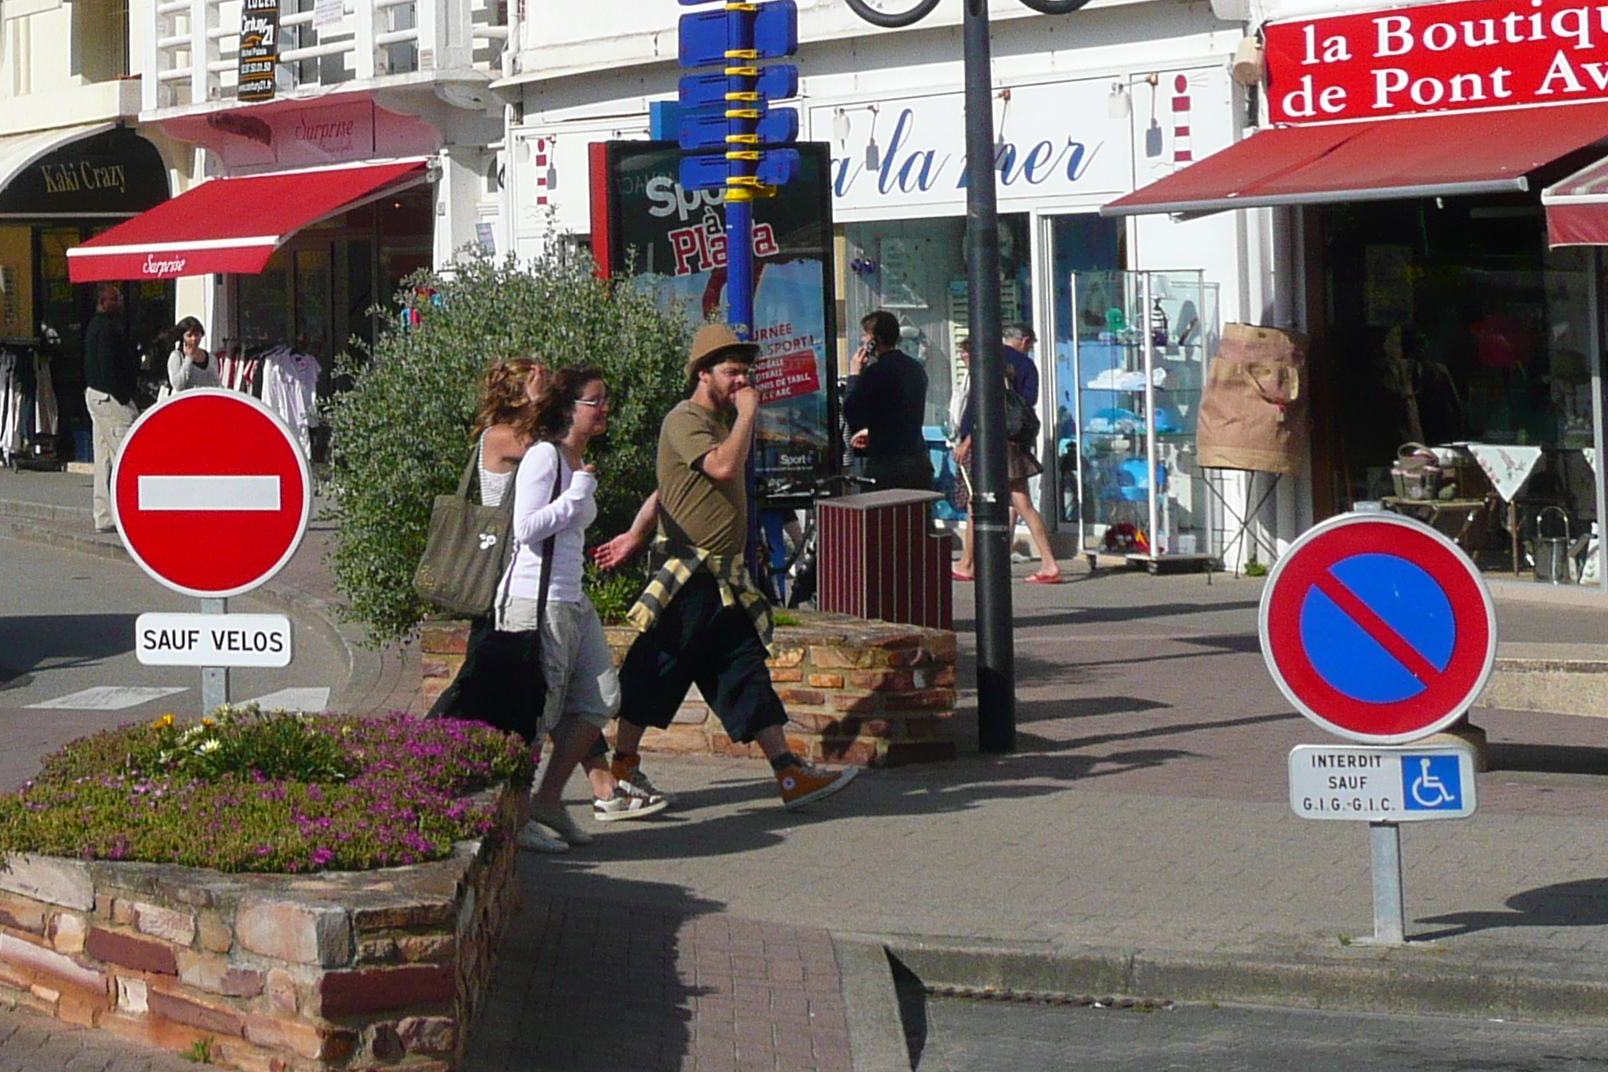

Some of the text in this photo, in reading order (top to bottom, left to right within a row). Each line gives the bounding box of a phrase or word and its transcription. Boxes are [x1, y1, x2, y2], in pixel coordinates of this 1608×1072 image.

[261, 24, 274, 45] 21
[1301, 24, 1352, 65] la
[1282, 74, 1347, 117] de
[1370, 67, 1512, 109] Pont
[294, 111, 355, 147] Surprise
[878, 108, 952, 195] la
[42, 159, 126, 193] Kaki Crazy
[646, 176, 728, 221] Spo
[704, 206, 722, 237] à
[668, 221, 780, 275] Plaa
[143, 253, 186, 278] Surprise
[776, 378, 786, 387] DE
[143, 629, 284, 653] SAUF VELOS
[1311, 755, 1382, 768] INTERDIT
[1328, 776, 1368, 789] SAUF
